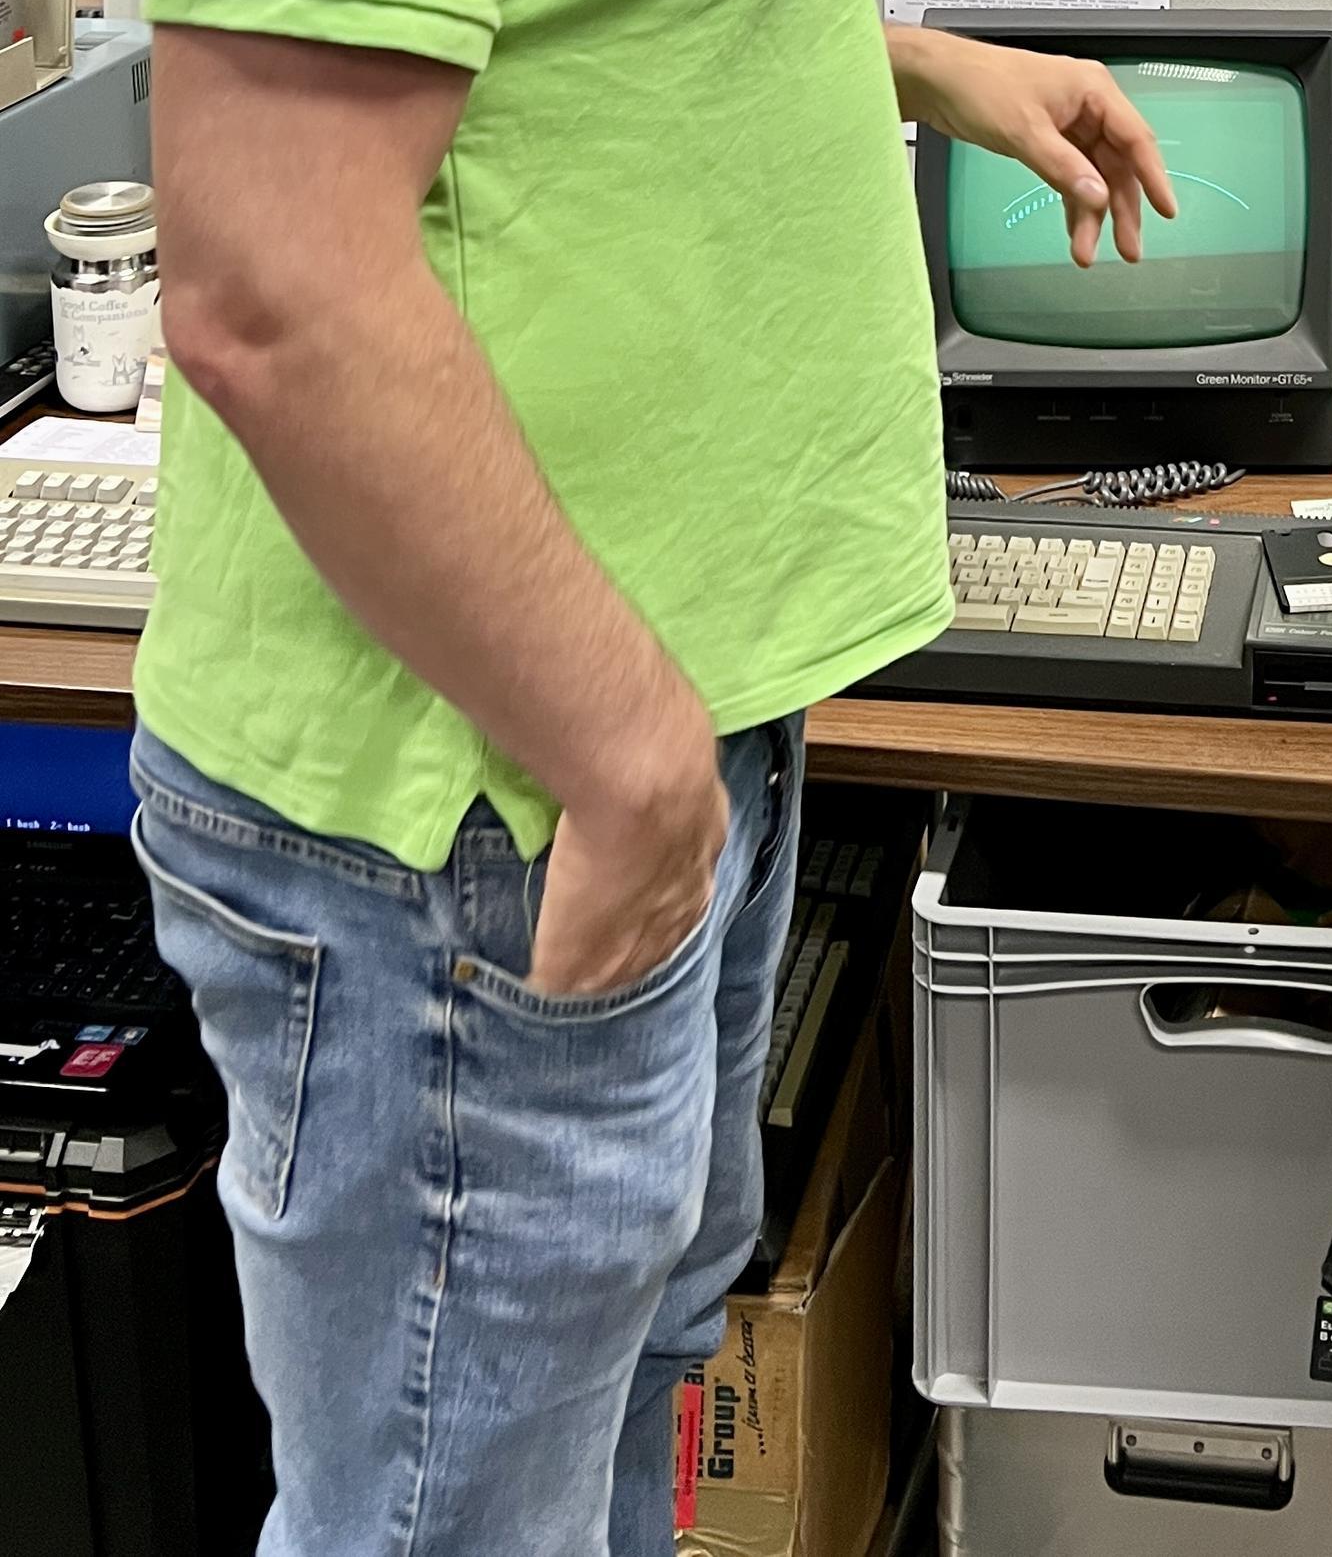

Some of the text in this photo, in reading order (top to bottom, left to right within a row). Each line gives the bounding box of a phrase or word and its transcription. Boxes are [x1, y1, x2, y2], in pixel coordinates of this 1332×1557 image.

[89, 300, 128, 311] Coffee
[71, 308, 148, 324] Companions
[1197, 374, 1229, 384] Green
[1230, 374, 1271, 384] Monitor
[17, 819, 40, 829] bash
[67, 822, 90, 832] bash
[1320, 1331, 1328, 1341] B
[707, 1386, 741, 1479] Group
